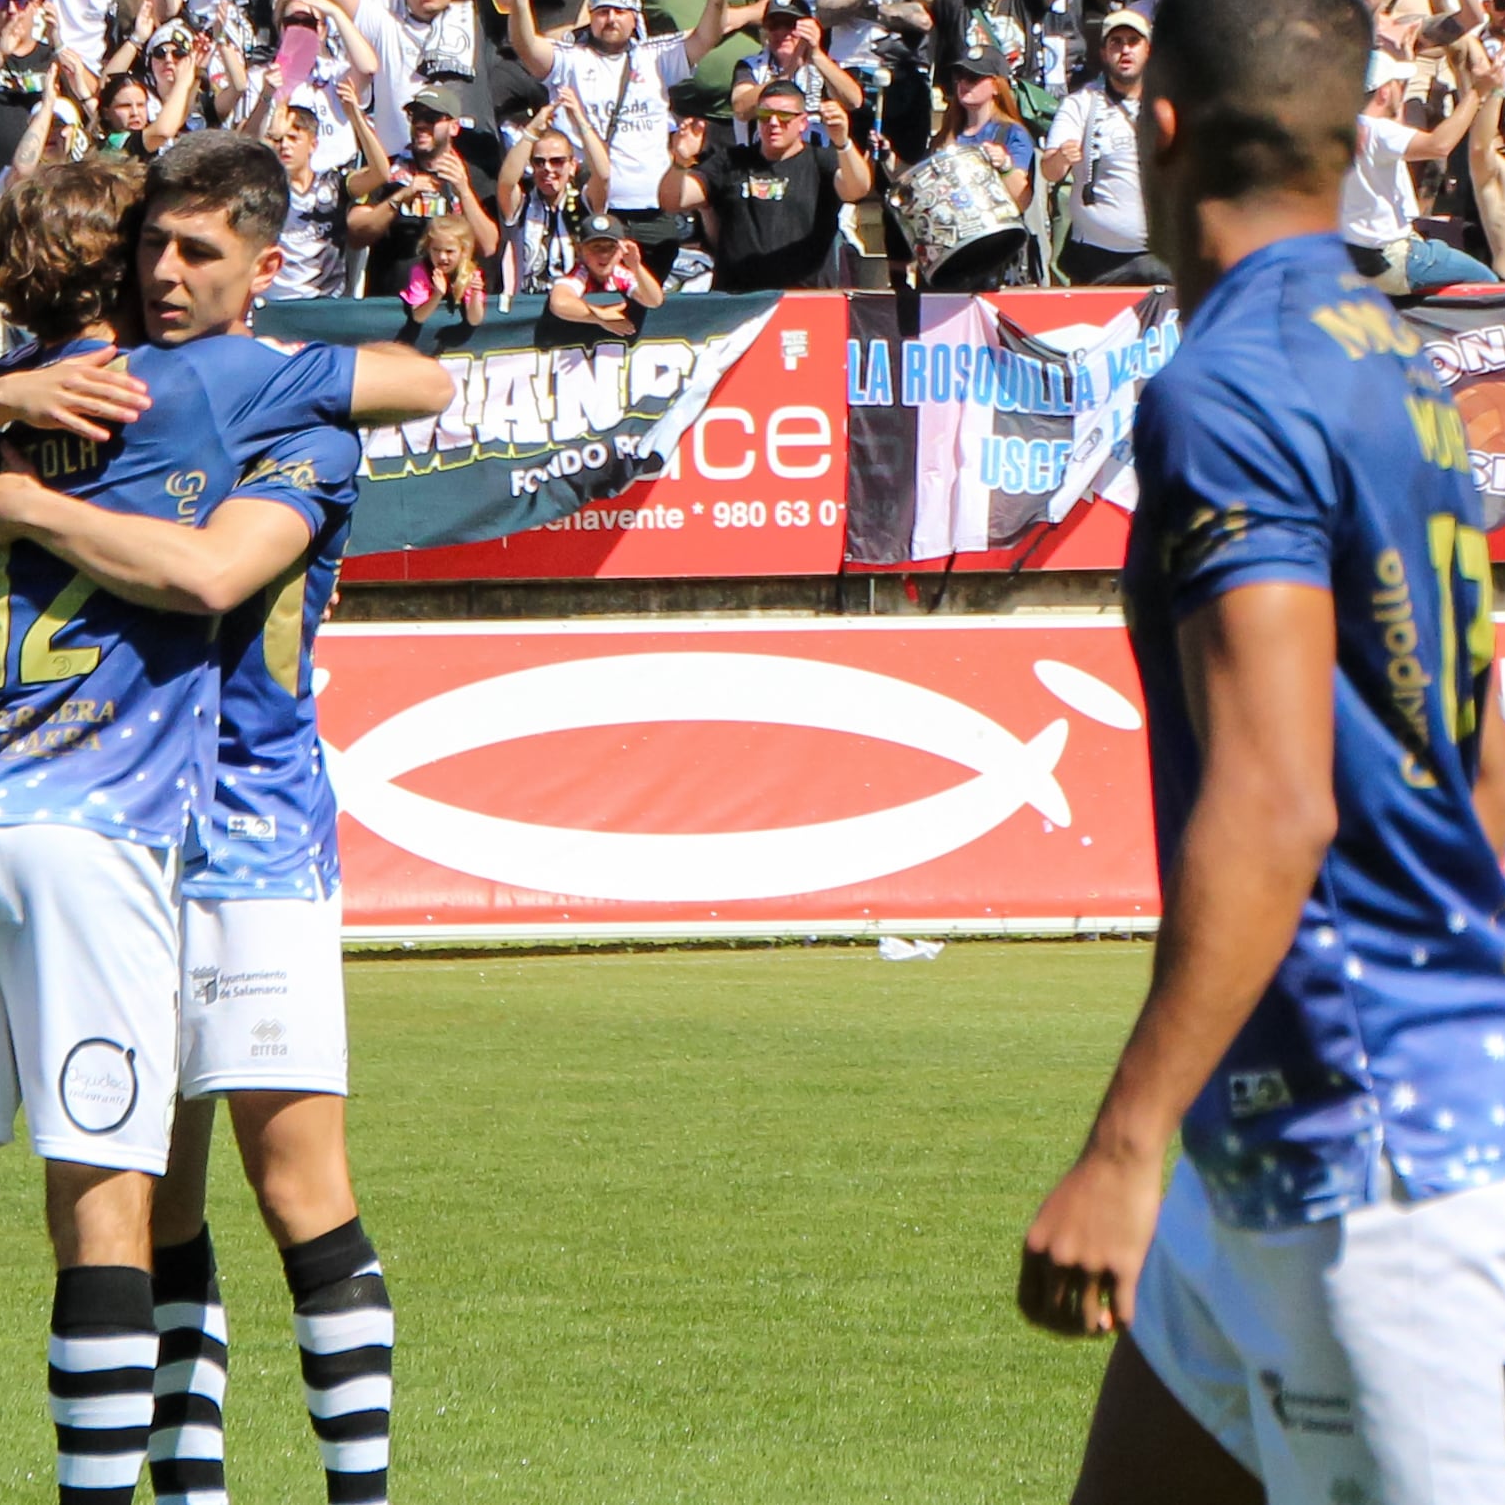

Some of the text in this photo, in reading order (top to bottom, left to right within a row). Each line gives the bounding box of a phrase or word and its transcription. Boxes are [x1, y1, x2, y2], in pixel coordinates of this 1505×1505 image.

[847, 339, 894, 406] LA
[901, 339, 1096, 417] ROSQUILLA
[712, 499, 767, 528] 980
[775, 499, 811, 527] 63
[231, 984, 288, 997] Salamanca
